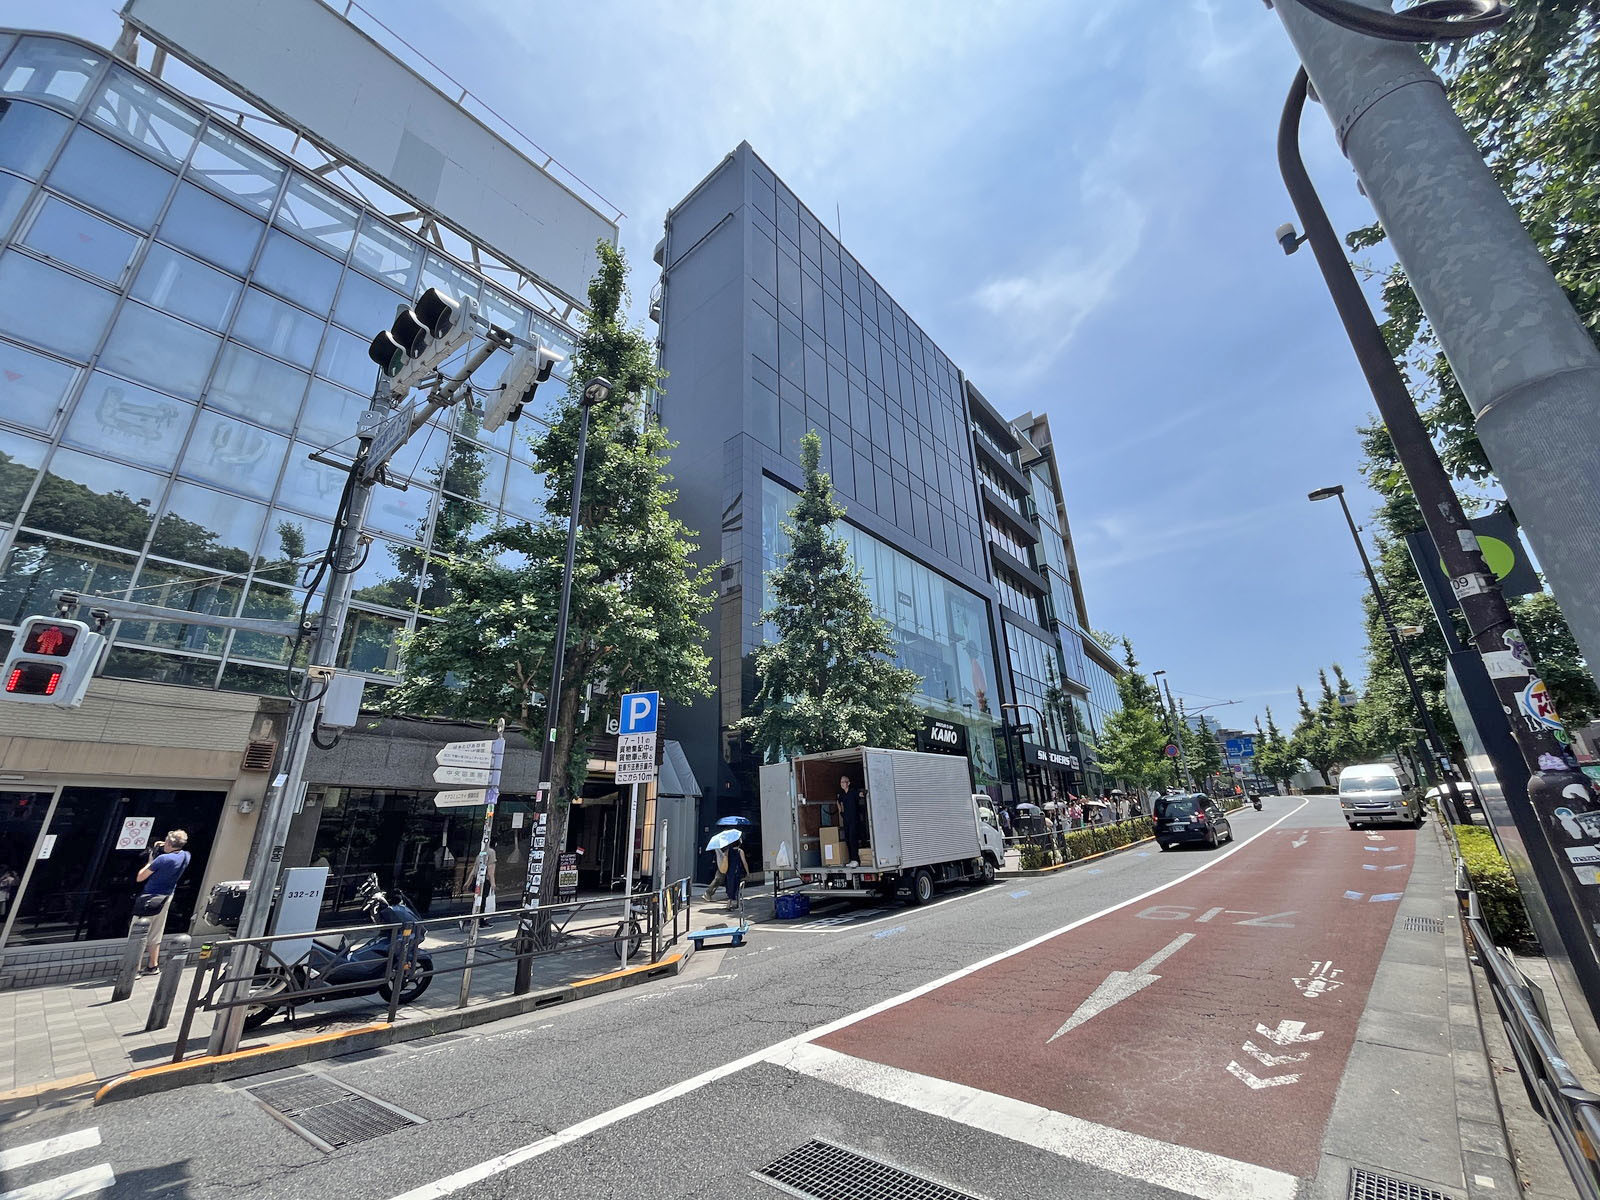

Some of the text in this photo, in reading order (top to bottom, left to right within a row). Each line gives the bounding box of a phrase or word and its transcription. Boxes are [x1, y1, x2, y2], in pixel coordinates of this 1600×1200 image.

[629, 697, 651, 730] P
[931, 727, 957, 745] KAMO
[288, 890, 319, 899] 332-21
